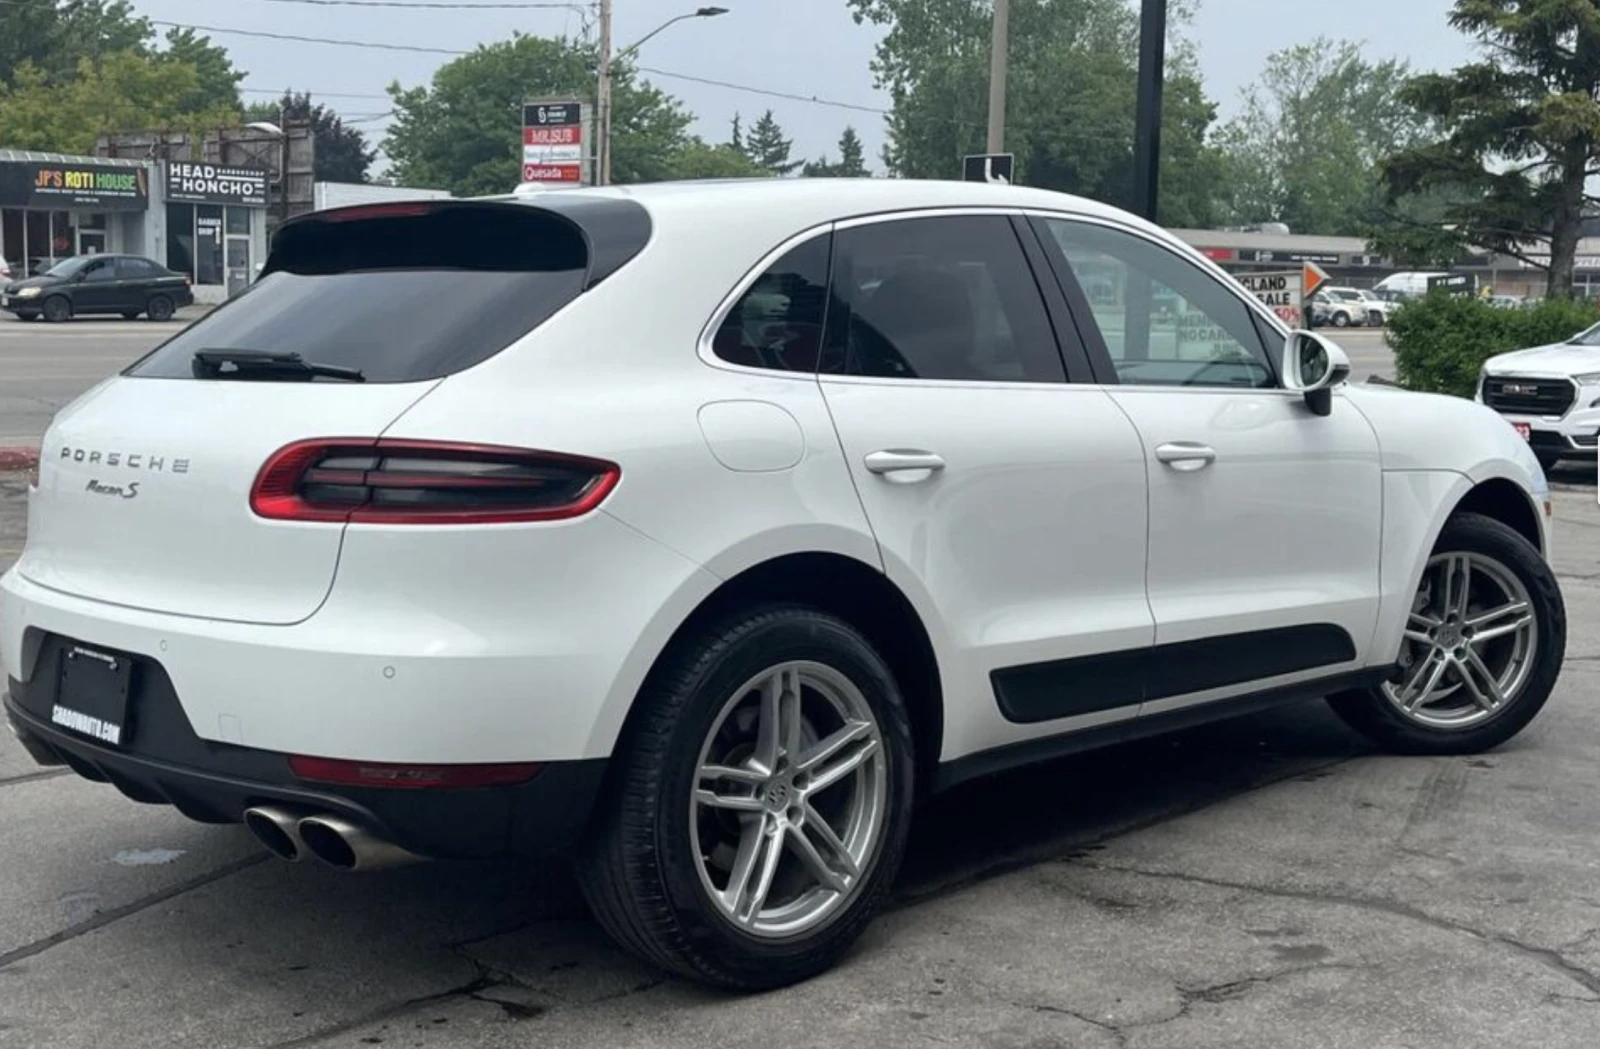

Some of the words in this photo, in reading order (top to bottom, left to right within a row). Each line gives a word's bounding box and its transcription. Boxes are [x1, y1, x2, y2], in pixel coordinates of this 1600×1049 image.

[170, 163, 215, 178] HEAD
[525, 166, 562, 180] Quesada
[35, 170, 62, 187] JP'S
[65, 171, 94, 188] ROTI
[96, 172, 136, 190] HOUSE
[182, 179, 254, 195] HONCHO
[1257, 292, 1291, 306] SALE
[60, 447, 190, 473] PORSCHE
